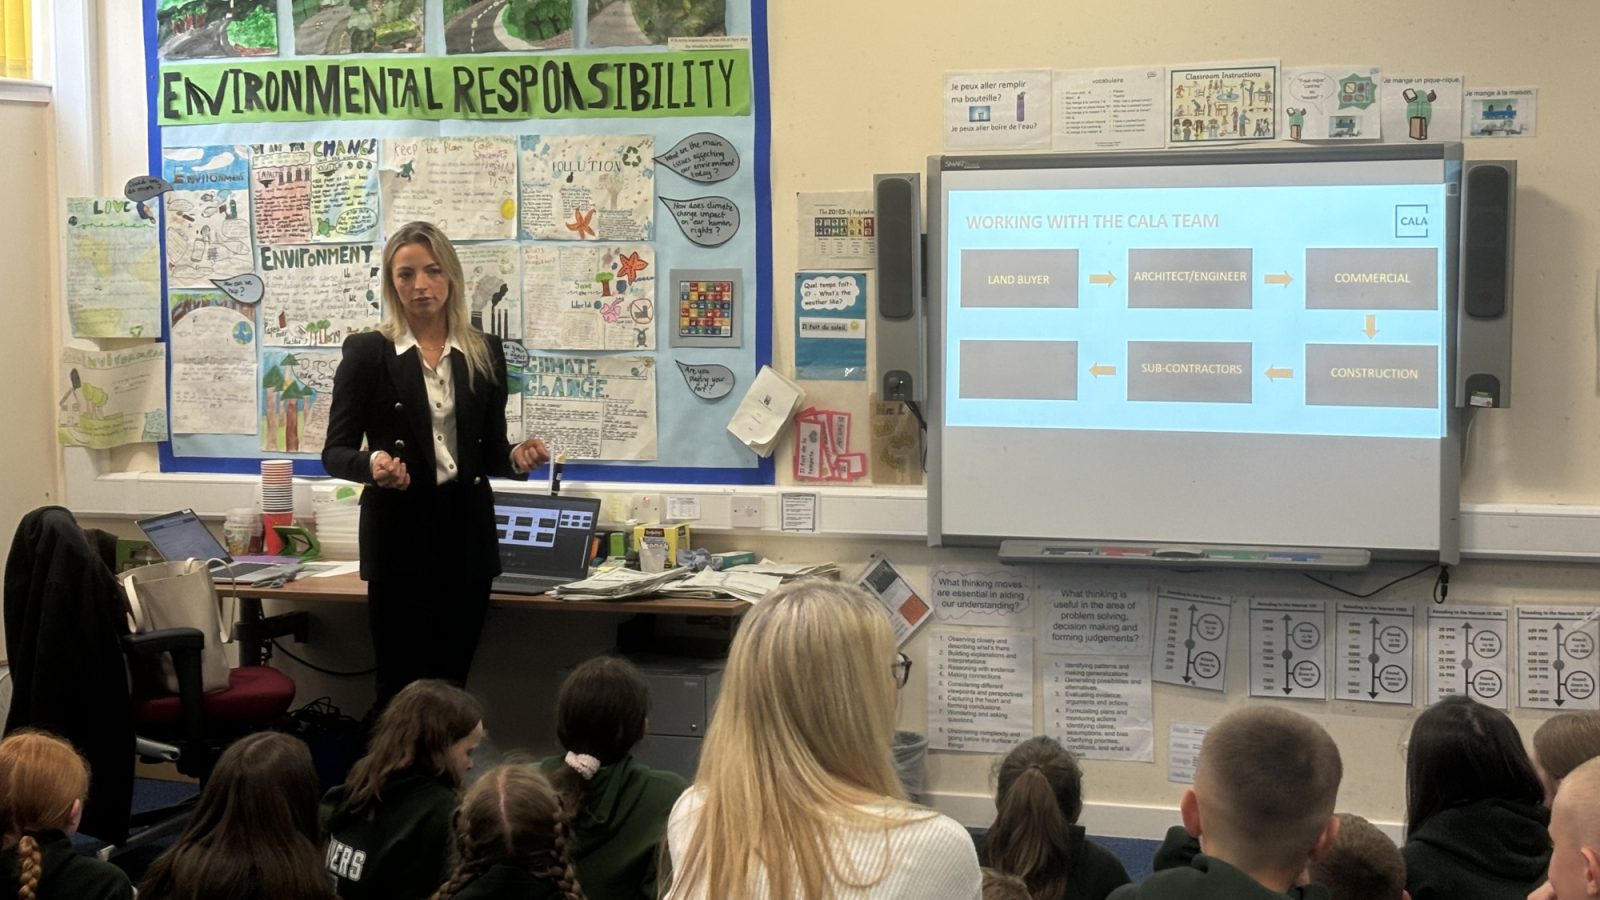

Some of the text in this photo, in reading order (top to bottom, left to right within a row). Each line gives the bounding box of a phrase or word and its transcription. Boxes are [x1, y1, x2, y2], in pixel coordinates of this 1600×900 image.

[1222, 71, 1261, 79] Instructions
[951, 80, 1026, 92] Je peux aller remplir
[1392, 77, 1414, 85] mange
[163, 59, 735, 119] ENVIRONMENTAL RESPONSIBILITY
[964, 94, 1002, 103] bouteille?
[990, 123, 1007, 131] boire
[313, 138, 377, 157] CHANGE
[689, 141, 701, 150] the
[702, 140, 722, 148] main
[552, 160, 622, 172] POLLUTION
[689, 200, 705, 209] does
[706, 200, 734, 212] climate
[676, 210, 726, 221] change impact
[1400, 216, 1428, 226] CALA
[966, 213, 1220, 230] WORKING WITH THE CALA TEAM
[988, 275, 1050, 285] LAND BUYER
[1134, 270, 1247, 283] ARCHITECT/ENGINEER
[1334, 273, 1411, 283] COMMERCIAL
[808, 323, 820, 331] fait
[1141, 363, 1243, 374] SUB-CONTRACTORS
[1330, 368, 1419, 380] CONSTRUCTION
[938, 578, 1023, 589] What thinking moves
[952, 590, 988, 598] essential
[989, 590, 998, 598] in
[999, 591, 1025, 601] aiding
[1061, 589, 1127, 600] What thinking is
[941, 600, 1020, 612] our understanding?
[1053, 601, 1079, 609] useful
[1080, 601, 1089, 609] in
[1090, 601, 1104, 609] the
[1127, 601, 1136, 610] of
[1060, 612, 1095, 621] problem
[1052, 622, 1138, 633] decision making and
[1052, 633, 1139, 644] forming judgements?
